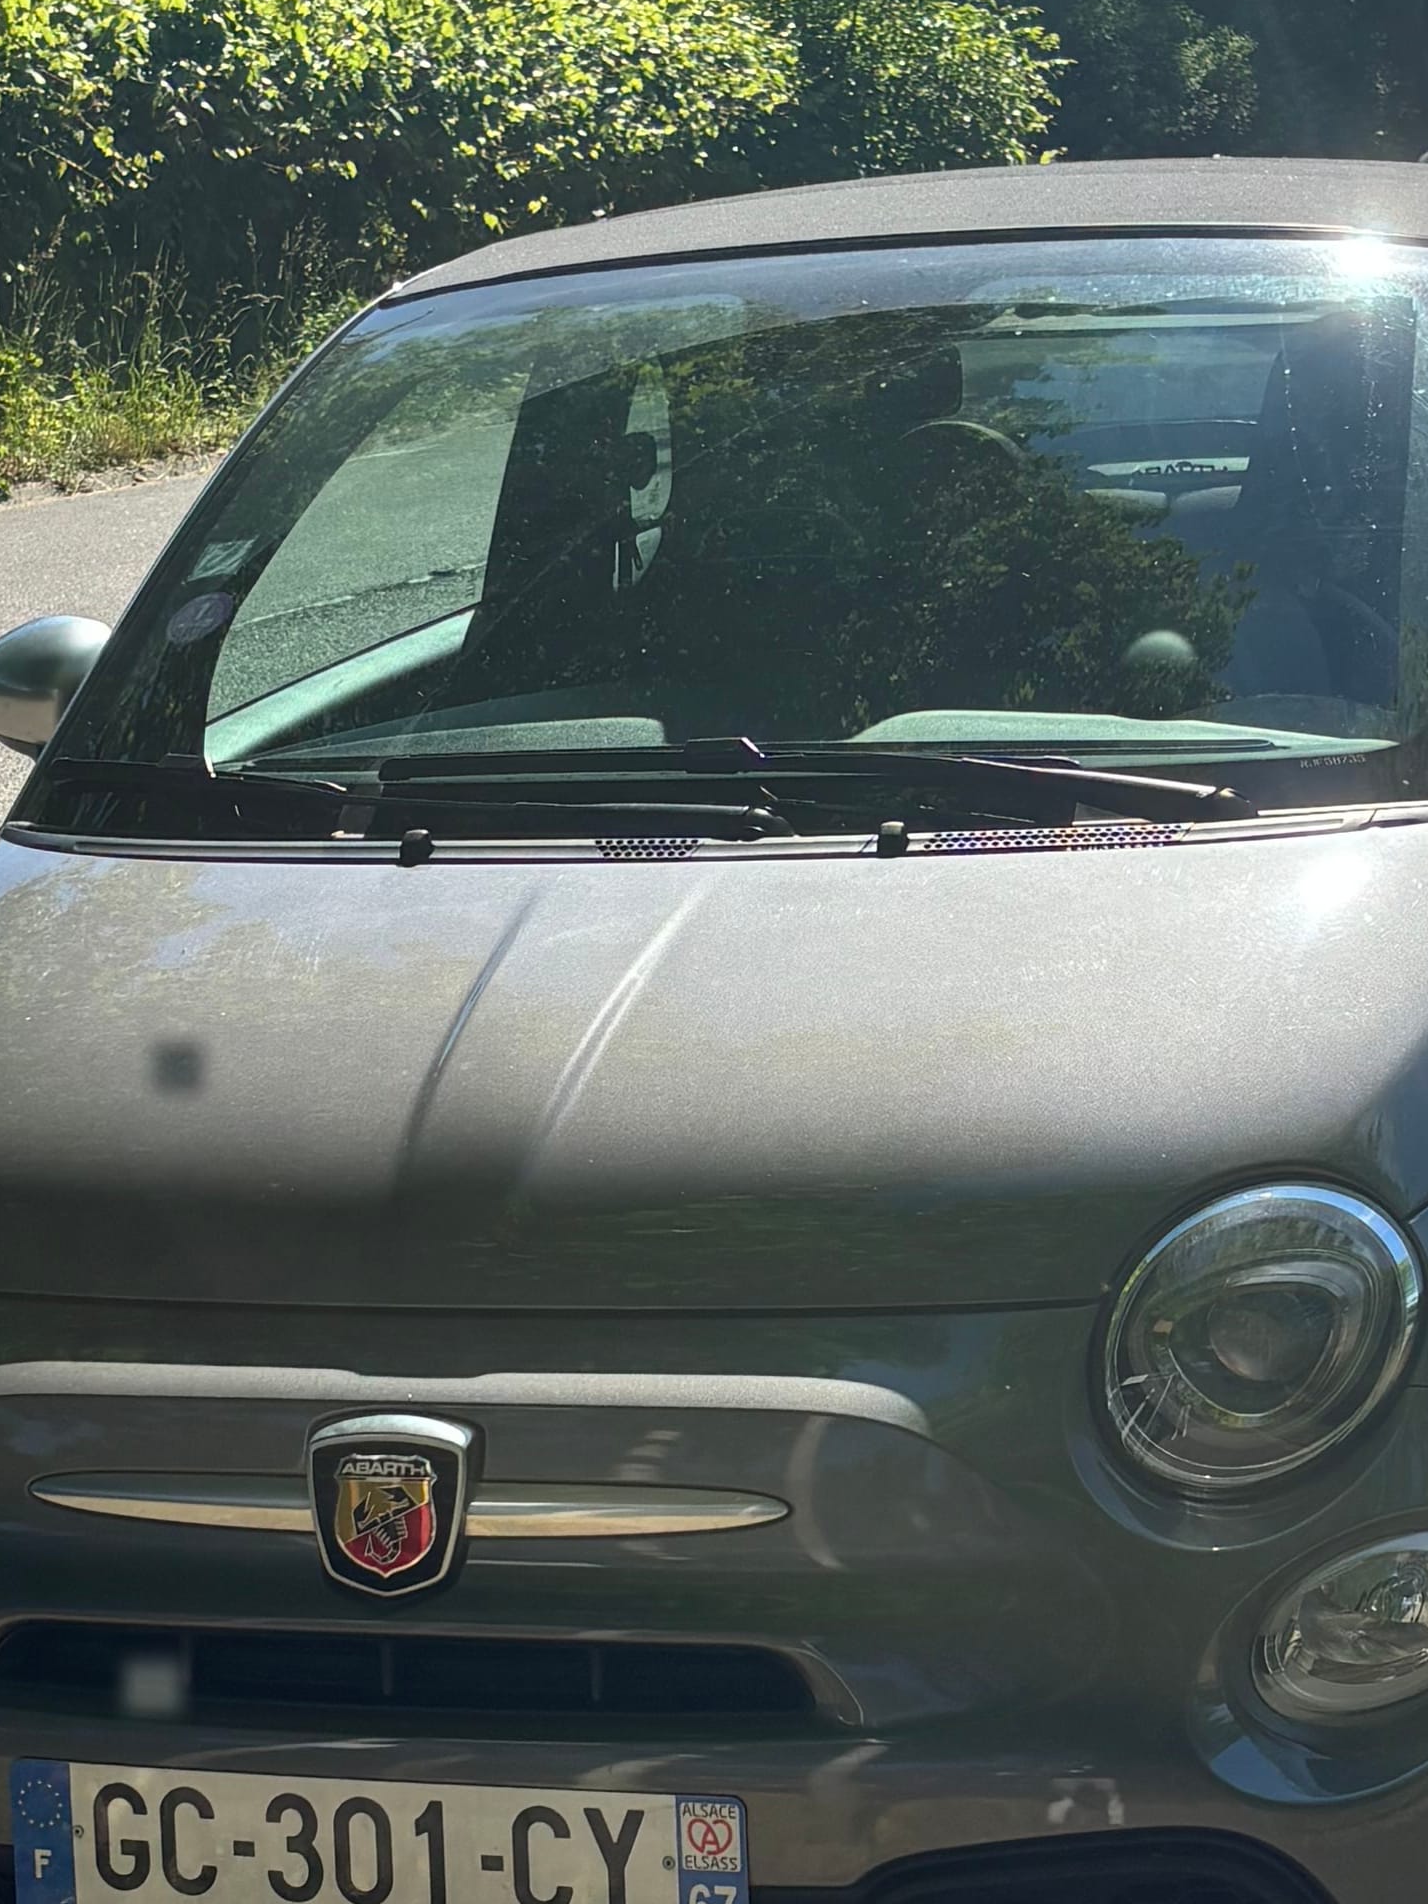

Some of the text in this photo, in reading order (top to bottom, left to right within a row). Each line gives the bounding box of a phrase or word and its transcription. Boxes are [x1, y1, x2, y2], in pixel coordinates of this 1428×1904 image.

[341, 1461, 425, 1476] ABARTH
[682, 1803, 737, 1819] ALSACE
[34, 1848, 52, 1879] F
[684, 1854, 738, 1871] ELSASS
